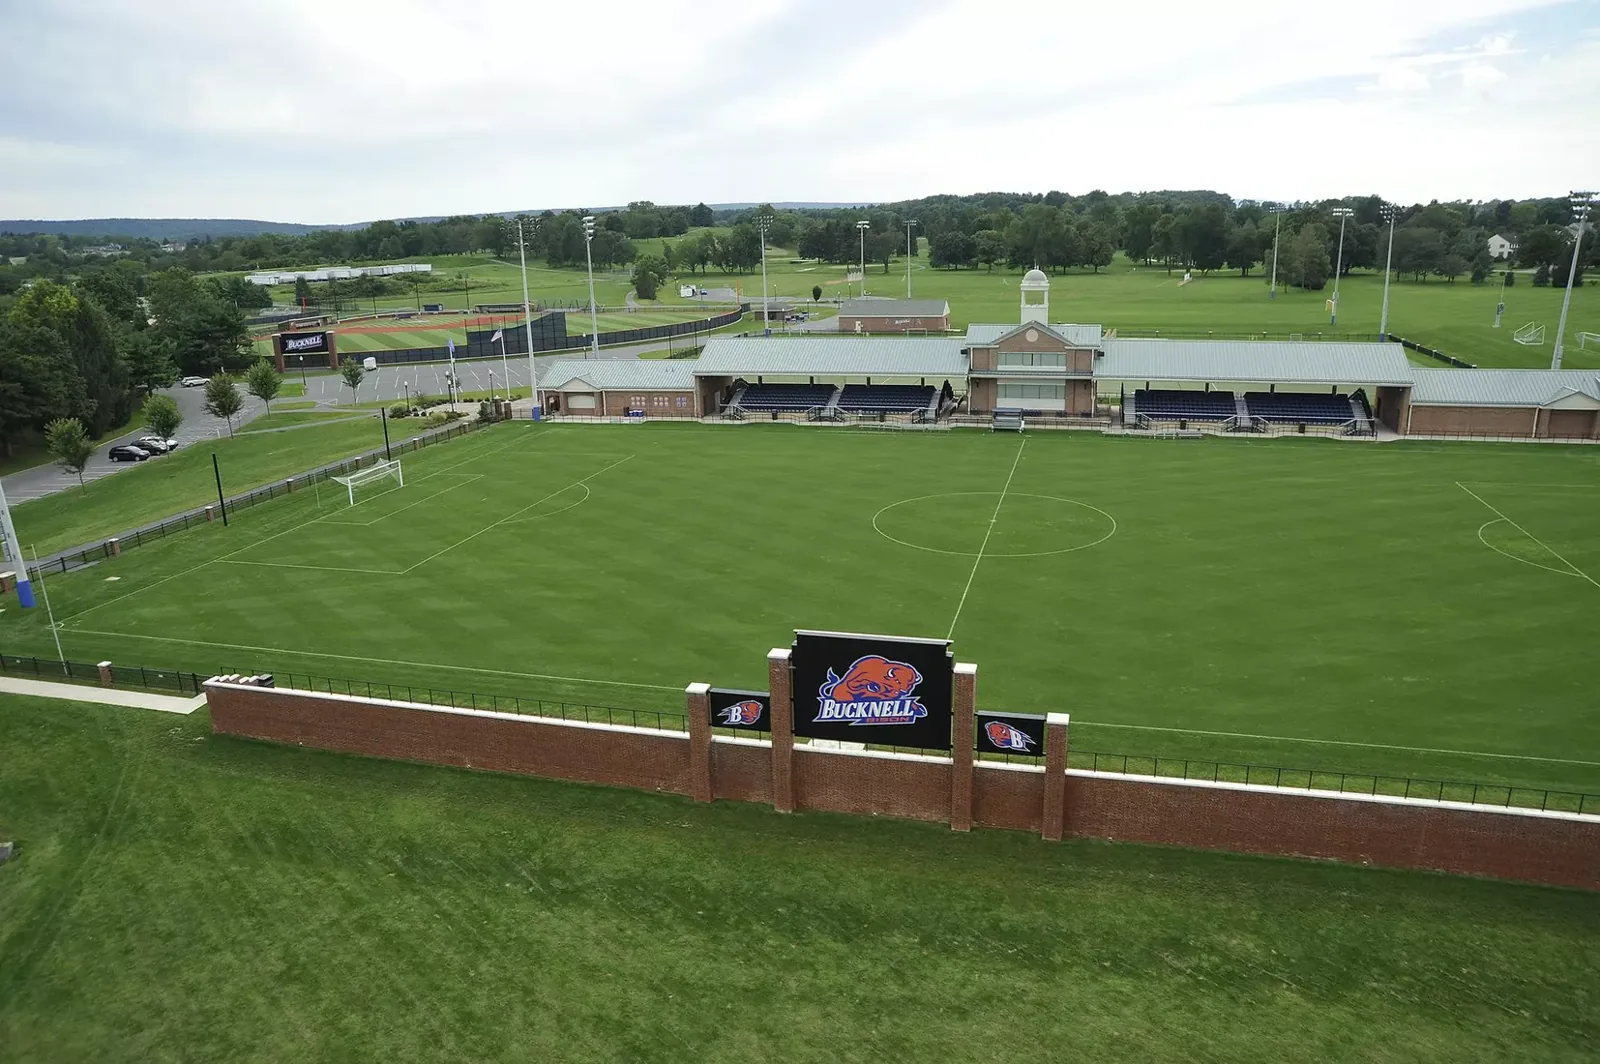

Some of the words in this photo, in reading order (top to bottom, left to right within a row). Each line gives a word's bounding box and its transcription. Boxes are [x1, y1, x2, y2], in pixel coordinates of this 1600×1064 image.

[287, 335, 323, 349] BUCKNELL
[729, 706, 742, 722] B
[820, 699, 915, 719] BUCKNELL
